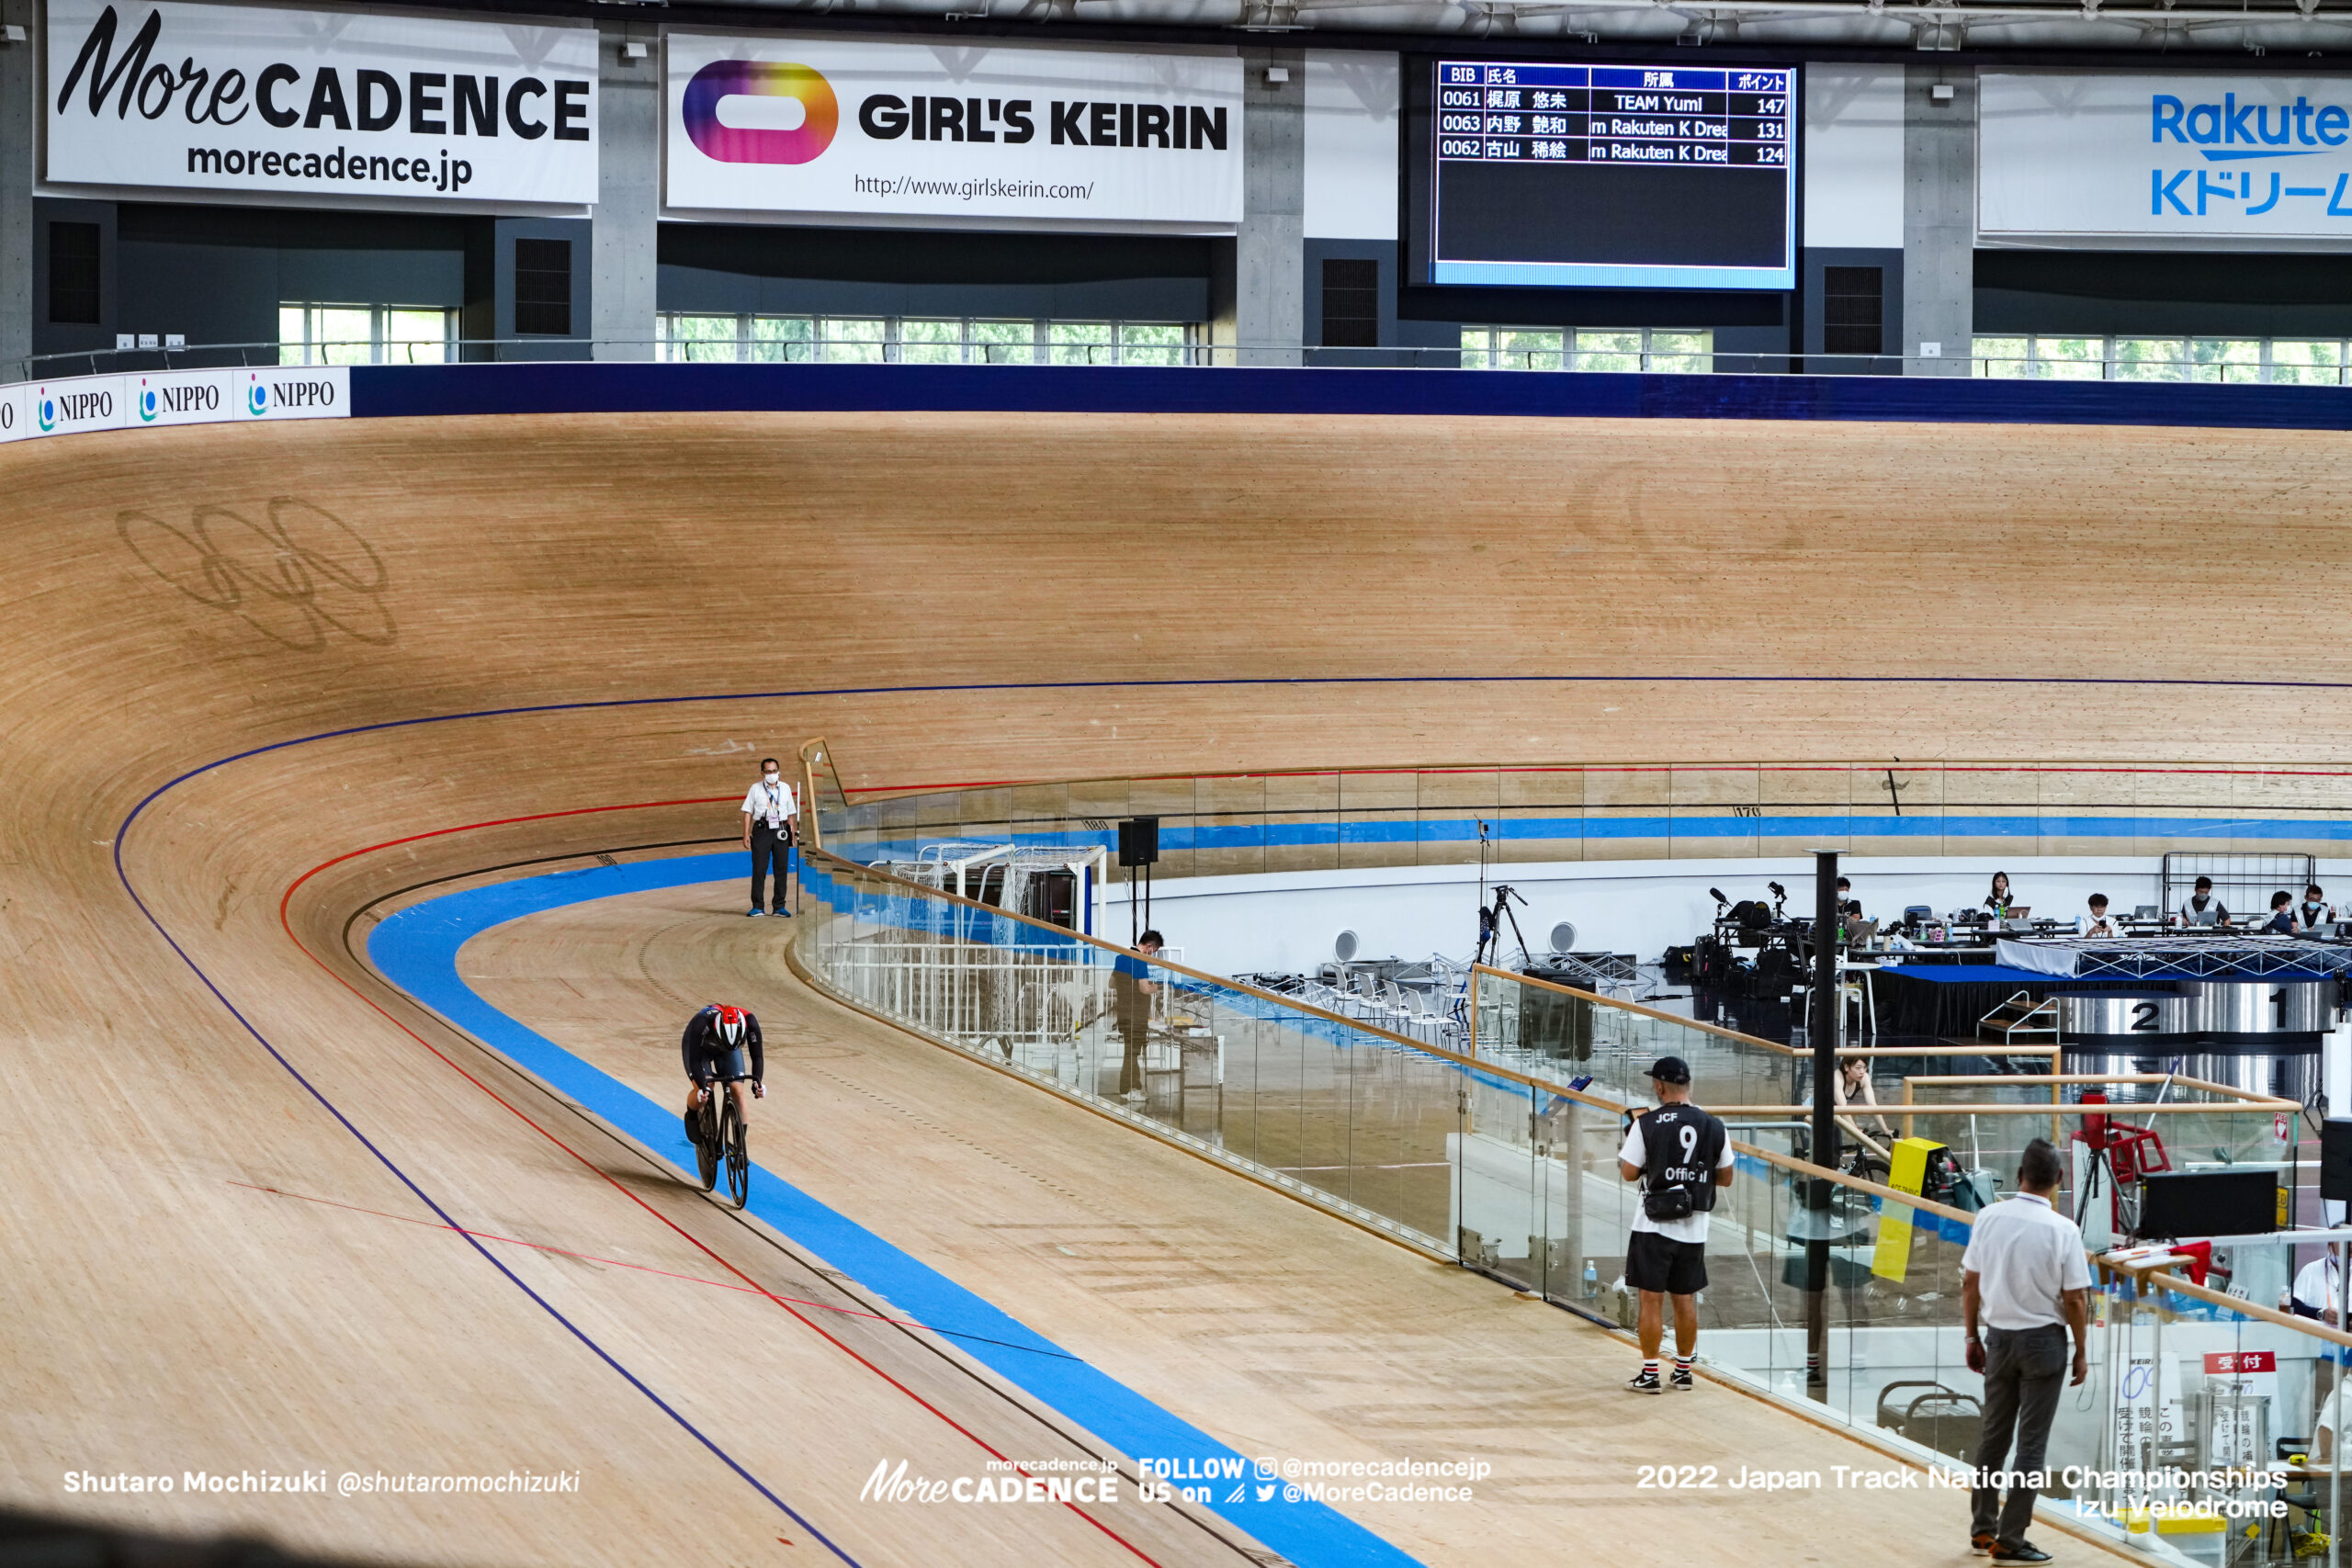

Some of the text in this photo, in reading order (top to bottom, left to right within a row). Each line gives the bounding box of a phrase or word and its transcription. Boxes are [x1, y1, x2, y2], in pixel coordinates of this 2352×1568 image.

[1451, 67, 1476, 83] BIB
[1487, 68, 1517, 85] 氏名
[1643, 72, 1675, 88] 所属
[1738, 73, 1784, 90] ポイント
[256, 62, 590, 141] CADENCE
[1443, 91, 1480, 107] 0061
[1487, 89, 1521, 108] 梶原
[1614, 95, 1659, 110] TEAM
[1757, 98, 1785, 114] 147
[858, 94, 1227, 151] GIRL'S KEIRIN
[1442, 115, 1480, 130] 0063
[1487, 115, 1521, 133] 内野
[1611, 119, 1674, 136] Rakuten
[1679, 120, 1690, 136] K
[2152, 92, 2350, 146] Rakute
[1757, 122, 1784, 139] 131
[1442, 140, 1480, 155] 0062
[1487, 140, 1520, 158] 古山
[1611, 143, 1674, 160] Rakuten
[1679, 145, 1690, 161] K
[1757, 147, 1785, 163] 124
[187, 143, 473, 192] morecadence.jp
[854, 174, 1094, 201] http://www.girlskeirin.com/
[162, 384, 220, 413] NIPPO
[273, 380, 335, 408] NIPPO
[59, 390, 113, 422] NIPPO
[2131, 1002, 2160, 1031] 2
[2269, 988, 2287, 1029] 1
[1655, 1112, 1679, 1123] JCF
[1679, 1124, 1698, 1164] 9
[2217, 1354, 2262, 1370] 受付
